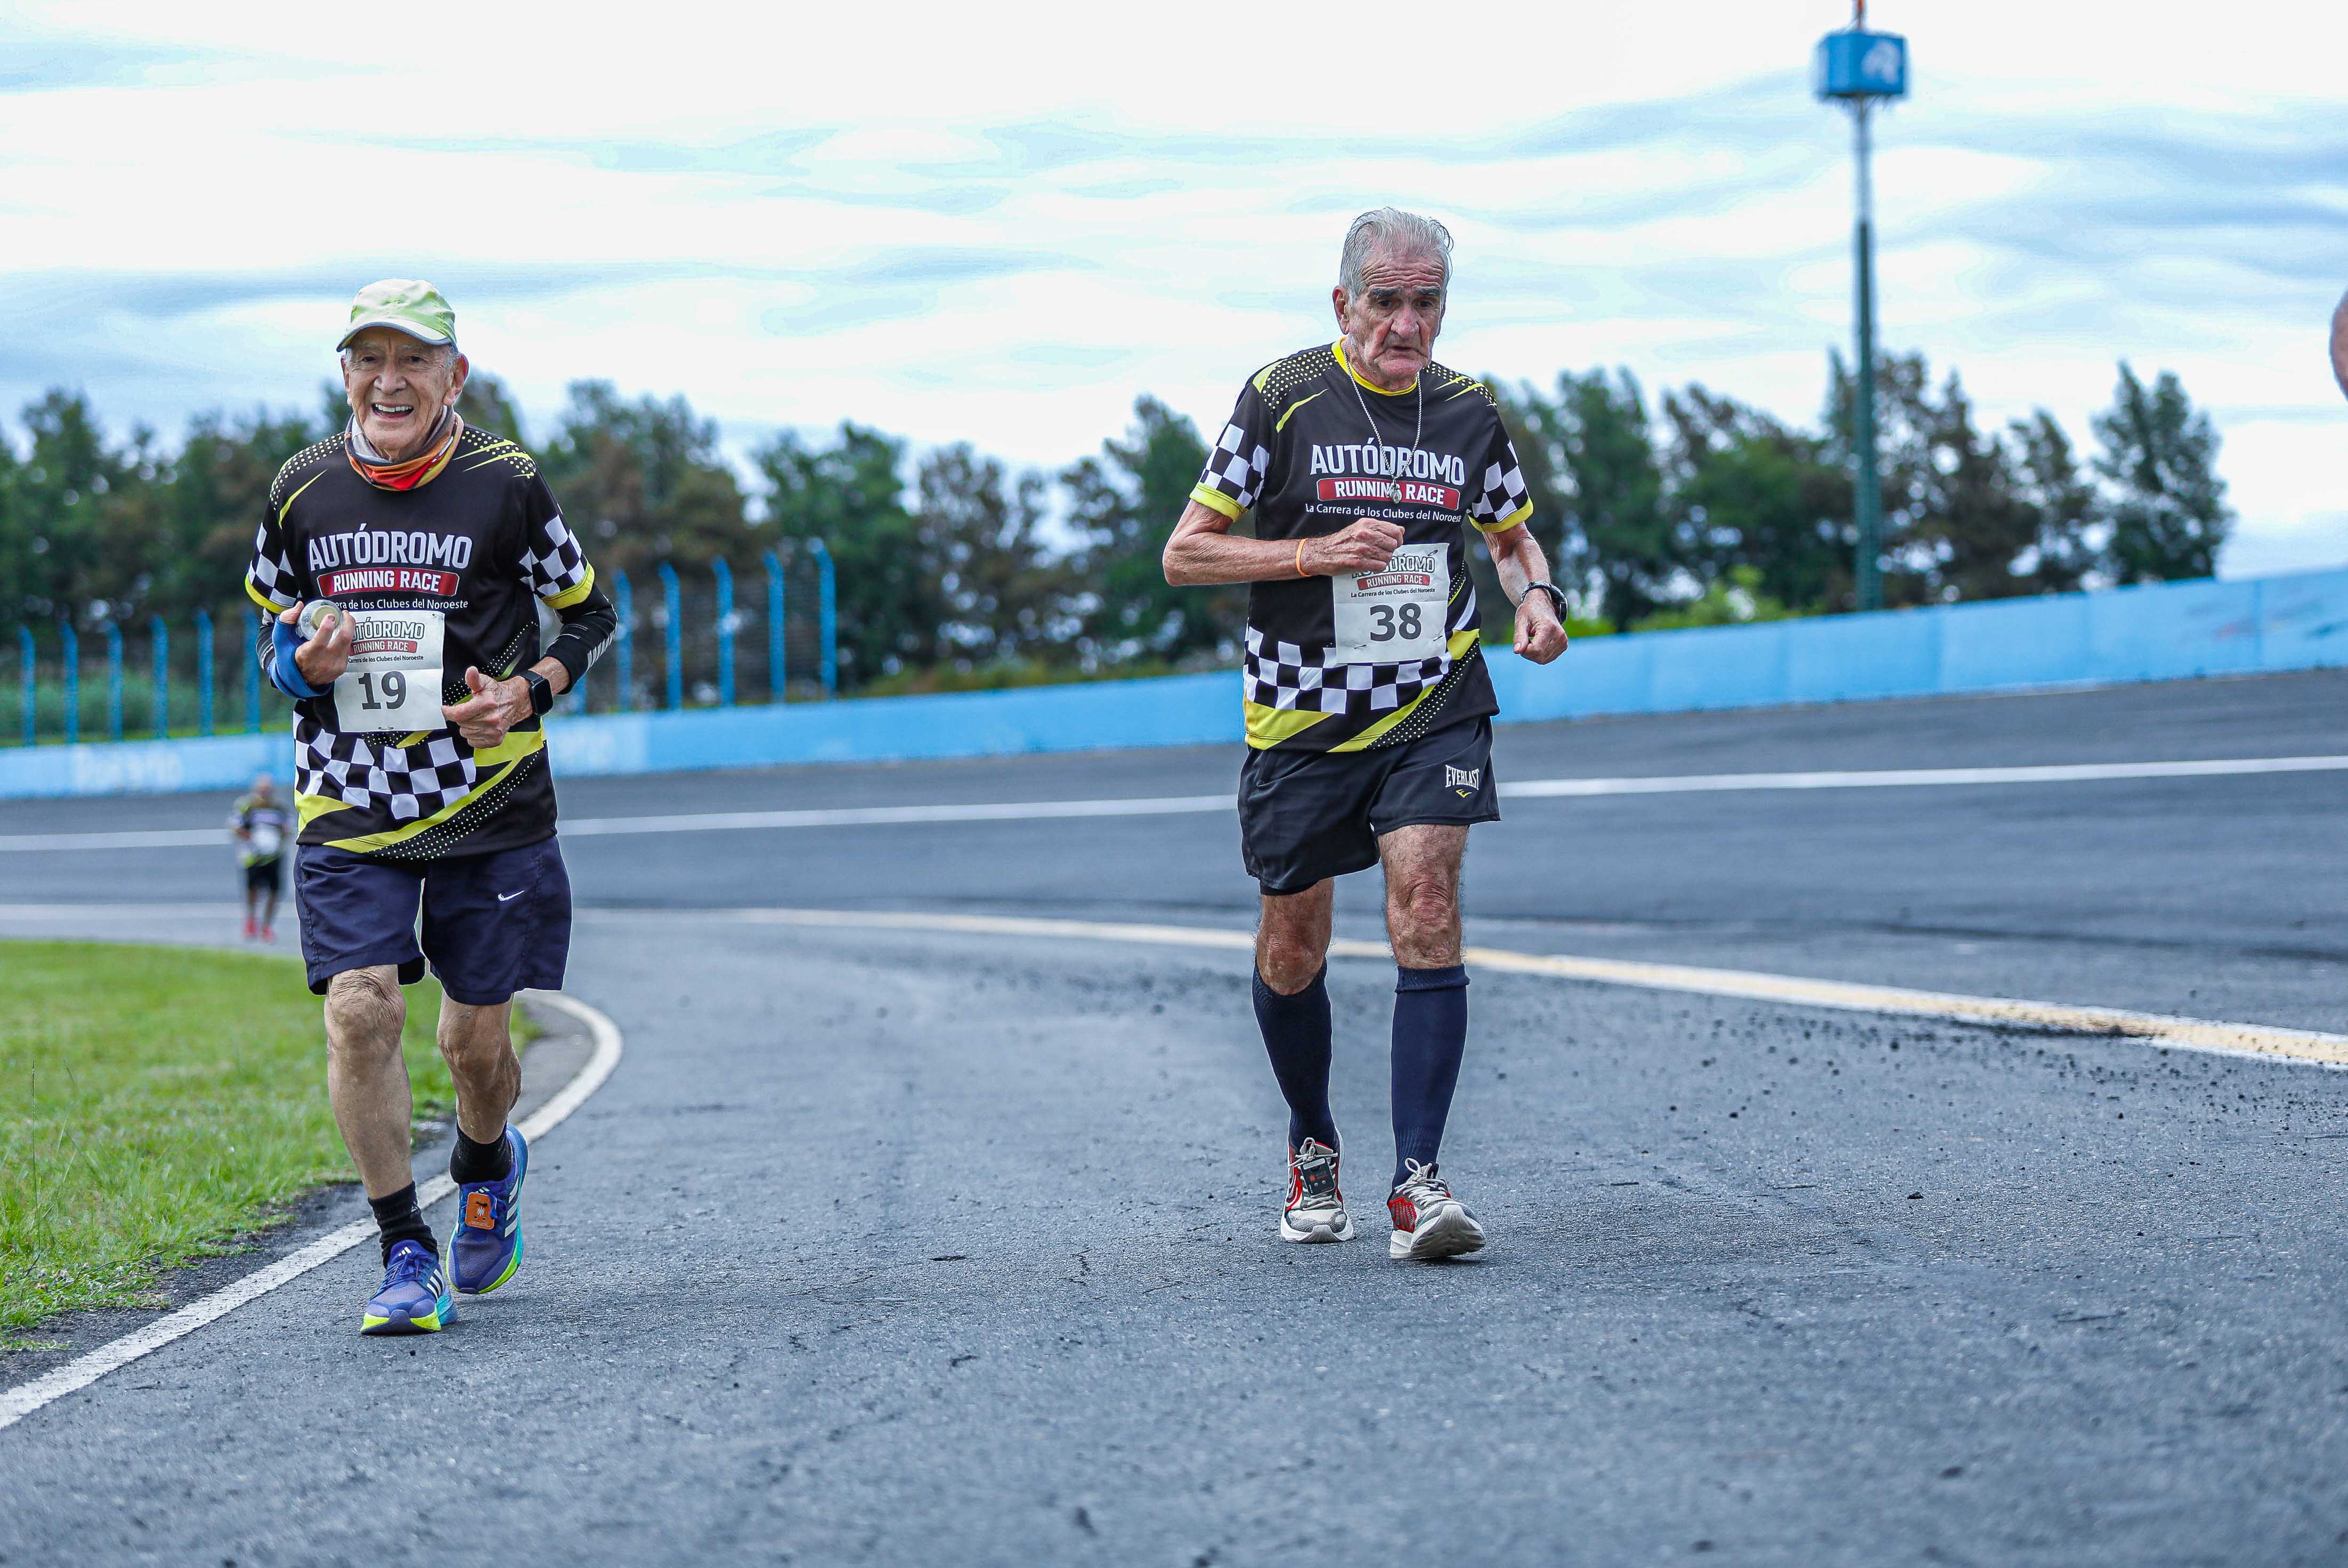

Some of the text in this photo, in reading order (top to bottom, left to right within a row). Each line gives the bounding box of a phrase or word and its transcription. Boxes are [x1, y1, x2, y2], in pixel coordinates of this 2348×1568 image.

[1334, 480, 1445, 505] RUNNIN RACE
[1305, 503, 1314, 513] La
[1317, 503, 1351, 515] Carrera
[1354, 506, 1366, 515] de
[1368, 507, 1380, 517] los
[1383, 508, 1414, 519] Clubes
[1416, 509, 1430, 521] del
[309, 523, 473, 572] AUTÓDROMO
[332, 570, 442, 593] RUNNING RACE
[1366, 574, 1423, 588] RUNNING RACE
[348, 599, 359, 609] de
[361, 599, 375, 609] los
[377, 599, 410, 609] Clubes
[412, 598, 425, 608] del
[427, 599, 468, 610] Noroeste
[352, 616, 425, 641] TÓDROMO
[1370, 603, 1422, 641] 38
[353, 640, 409, 654] RUNNING RACE
[358, 671, 407, 711] 19
[1445, 765, 1480, 791] EVERLAST
